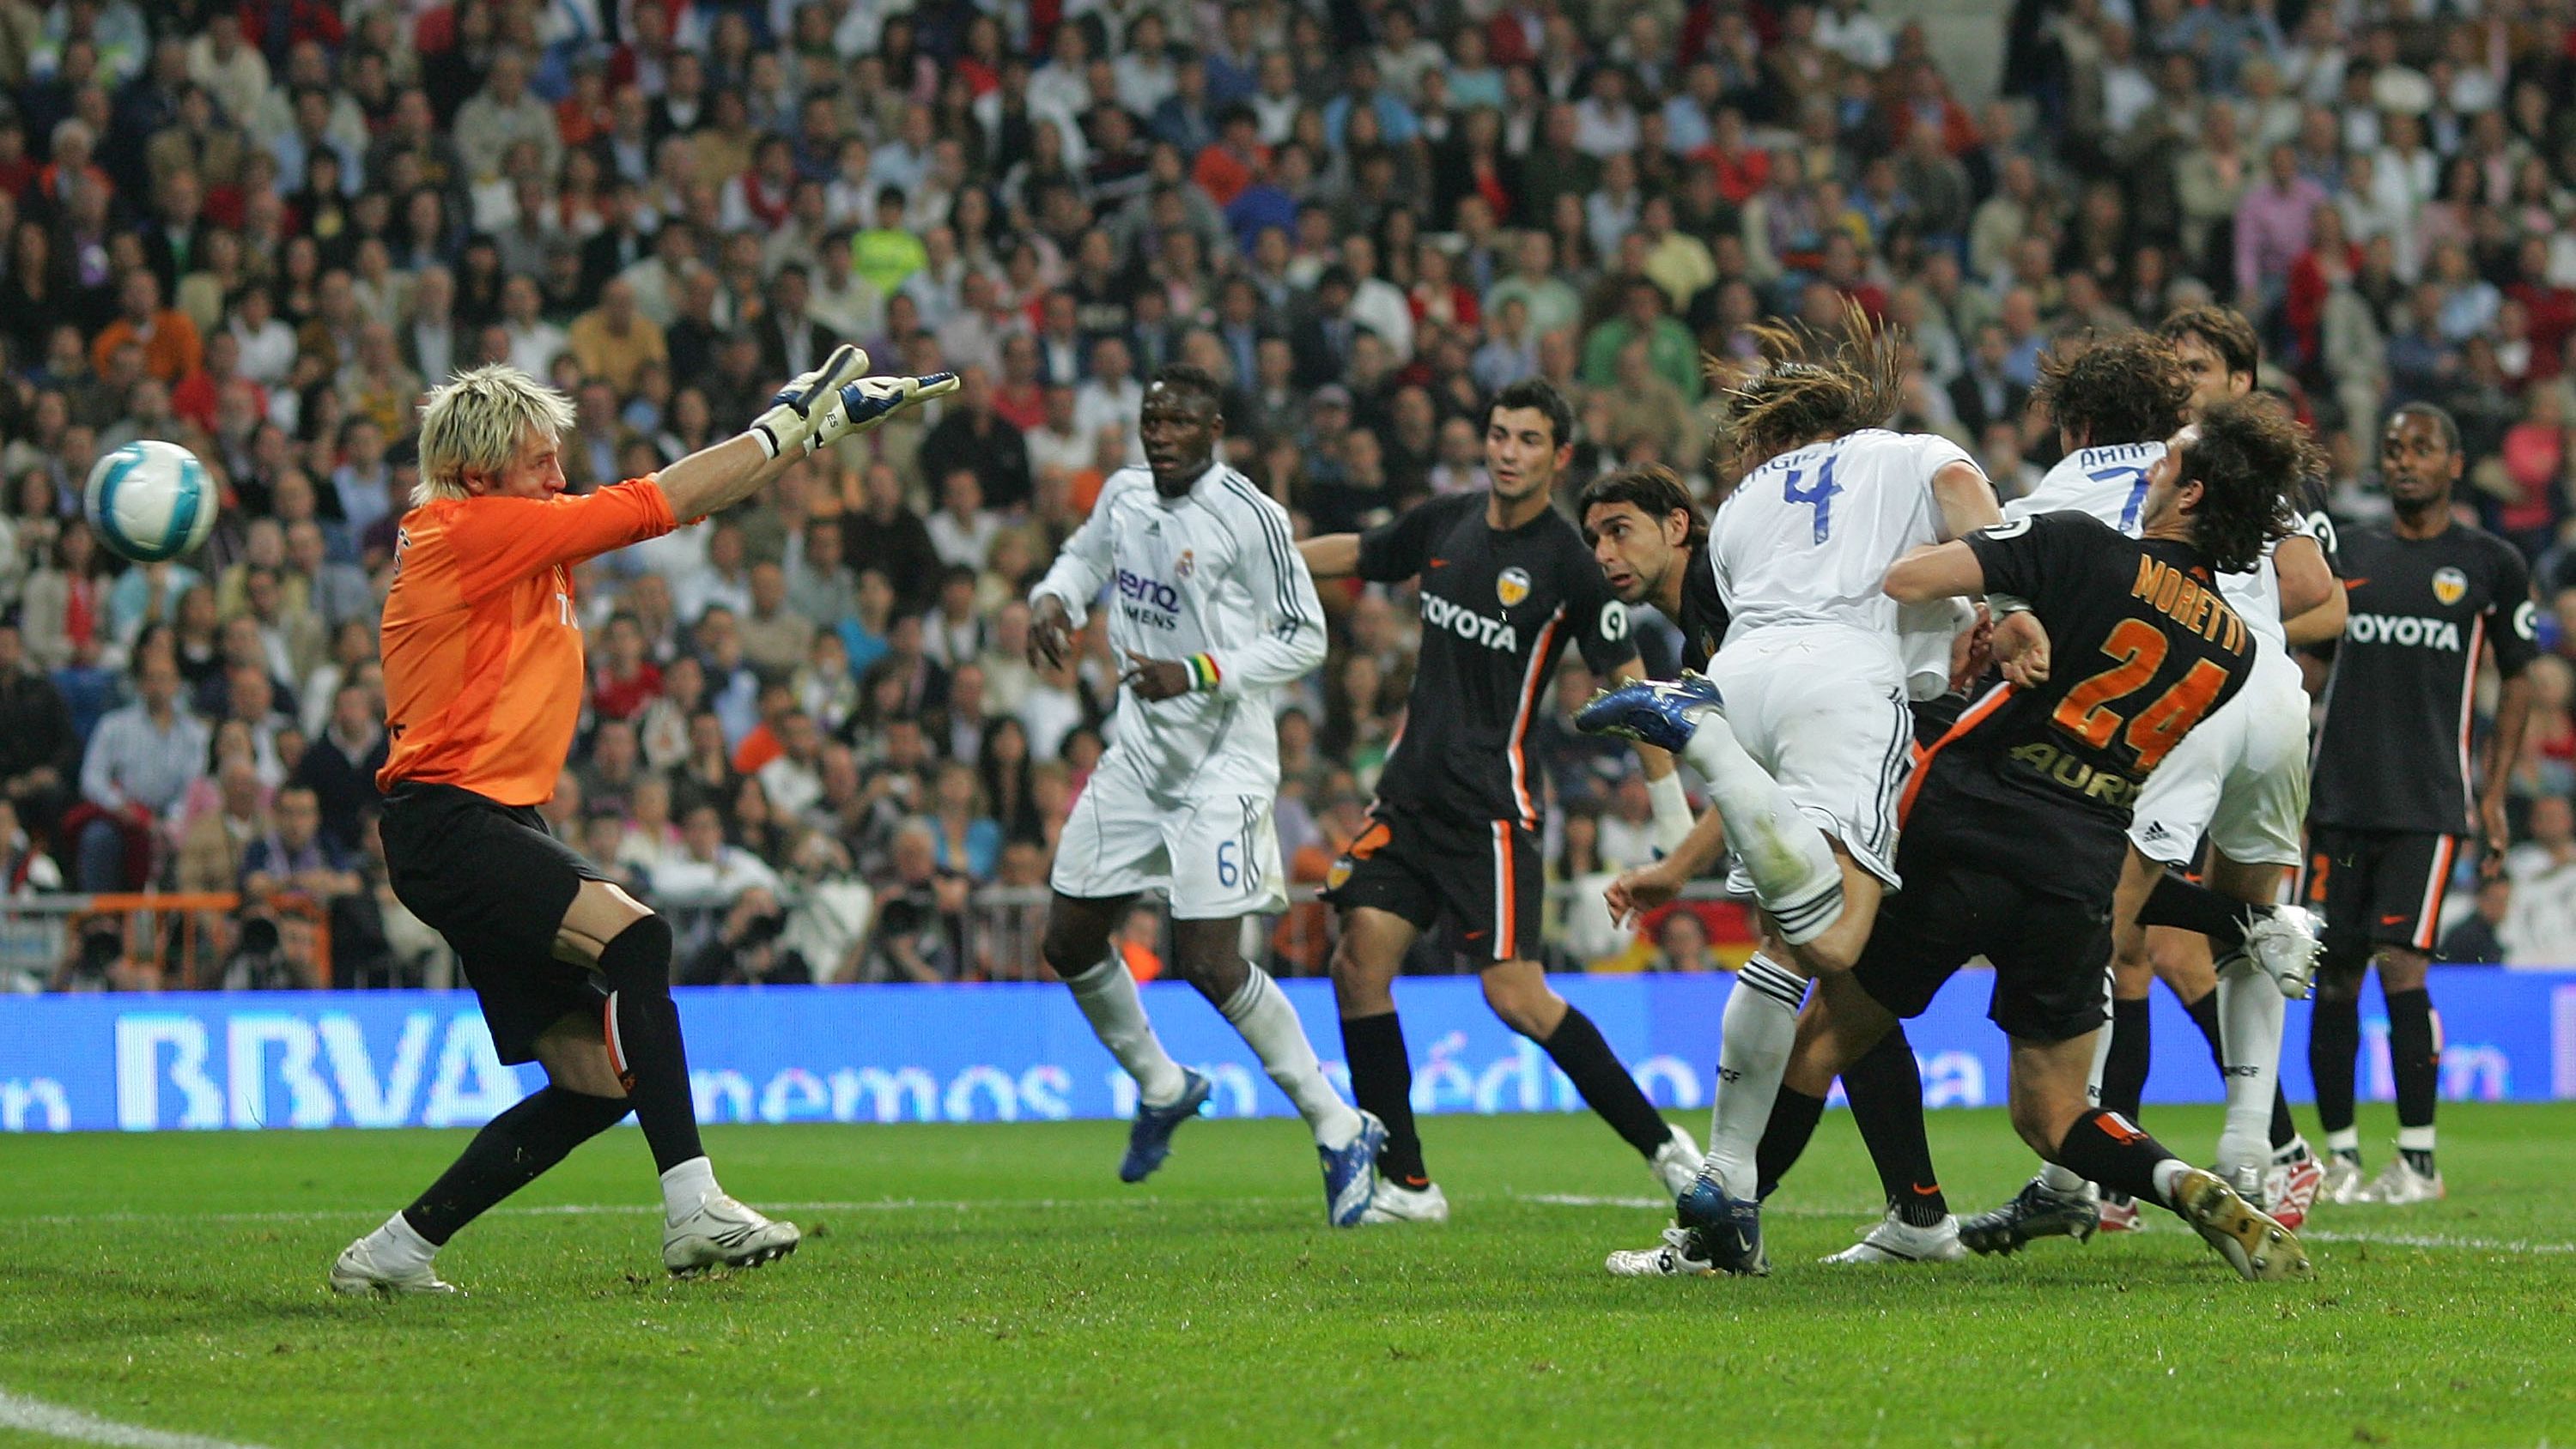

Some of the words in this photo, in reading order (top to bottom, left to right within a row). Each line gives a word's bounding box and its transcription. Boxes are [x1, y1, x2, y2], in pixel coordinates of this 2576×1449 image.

[1783, 452, 1845, 547] 4
[2087, 466, 2149, 532] 7
[2130, 552, 2247, 658] MORETTI
[2052, 617, 2230, 773] 24
[1217, 840, 1238, 888] 6
[115, 1010, 526, 1131] BBVA
